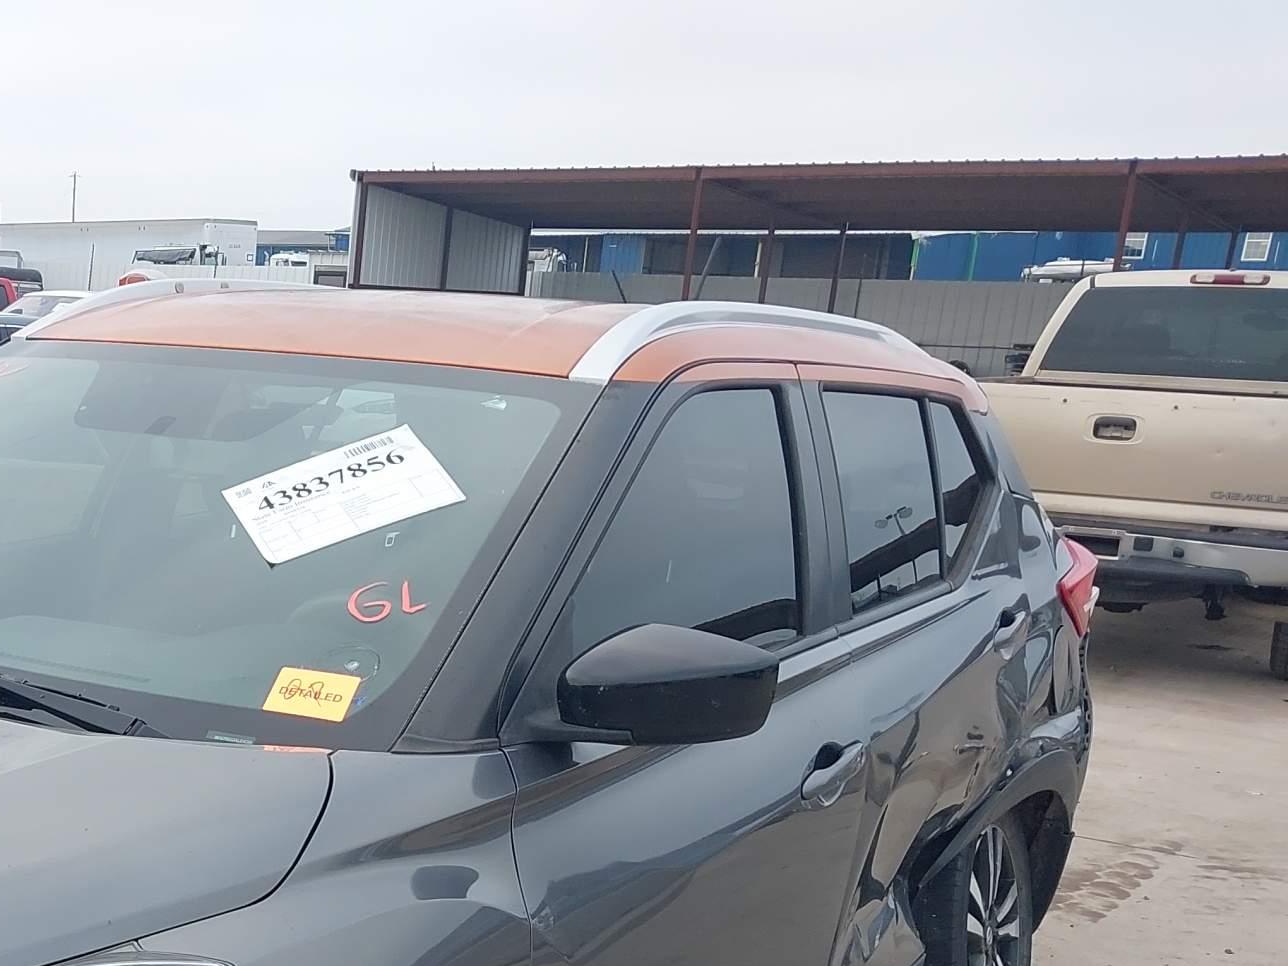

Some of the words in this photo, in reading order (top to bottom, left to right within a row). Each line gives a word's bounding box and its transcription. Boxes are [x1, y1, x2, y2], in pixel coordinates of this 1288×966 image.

[258, 448, 405, 511] 43837856
[1209, 490, 1288, 505] CHEVROLE
[347, 580, 431, 624] GL
[278, 686, 343, 703] DETAILED
